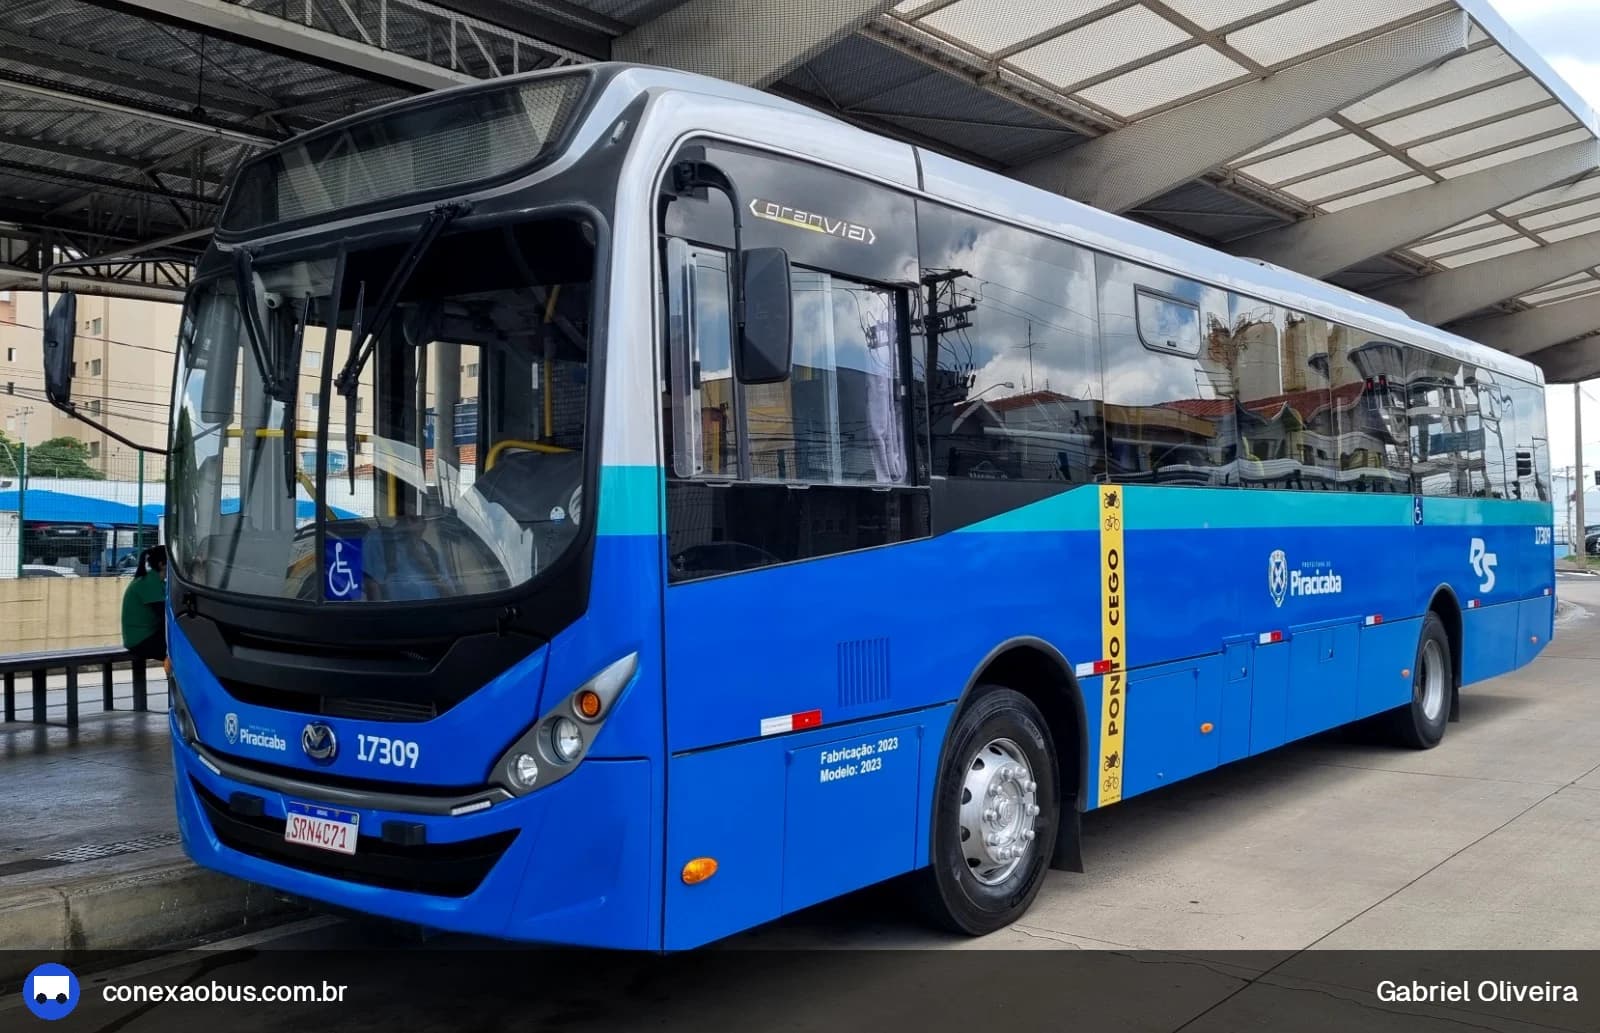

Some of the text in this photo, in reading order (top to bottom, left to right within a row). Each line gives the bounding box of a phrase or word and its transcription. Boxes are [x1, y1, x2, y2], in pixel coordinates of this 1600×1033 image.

[1290, 568, 1342, 596] Piracicaba
[1108, 549, 1120, 736] PONTO CEGO
[240, 728, 286, 751] Piracicaba
[357, 734, 419, 769] 17309
[820, 737, 898, 764] Fabricação: 2023
[820, 758, 882, 783] Modelo: 2023
[291, 816, 347, 849] SRN4C71
